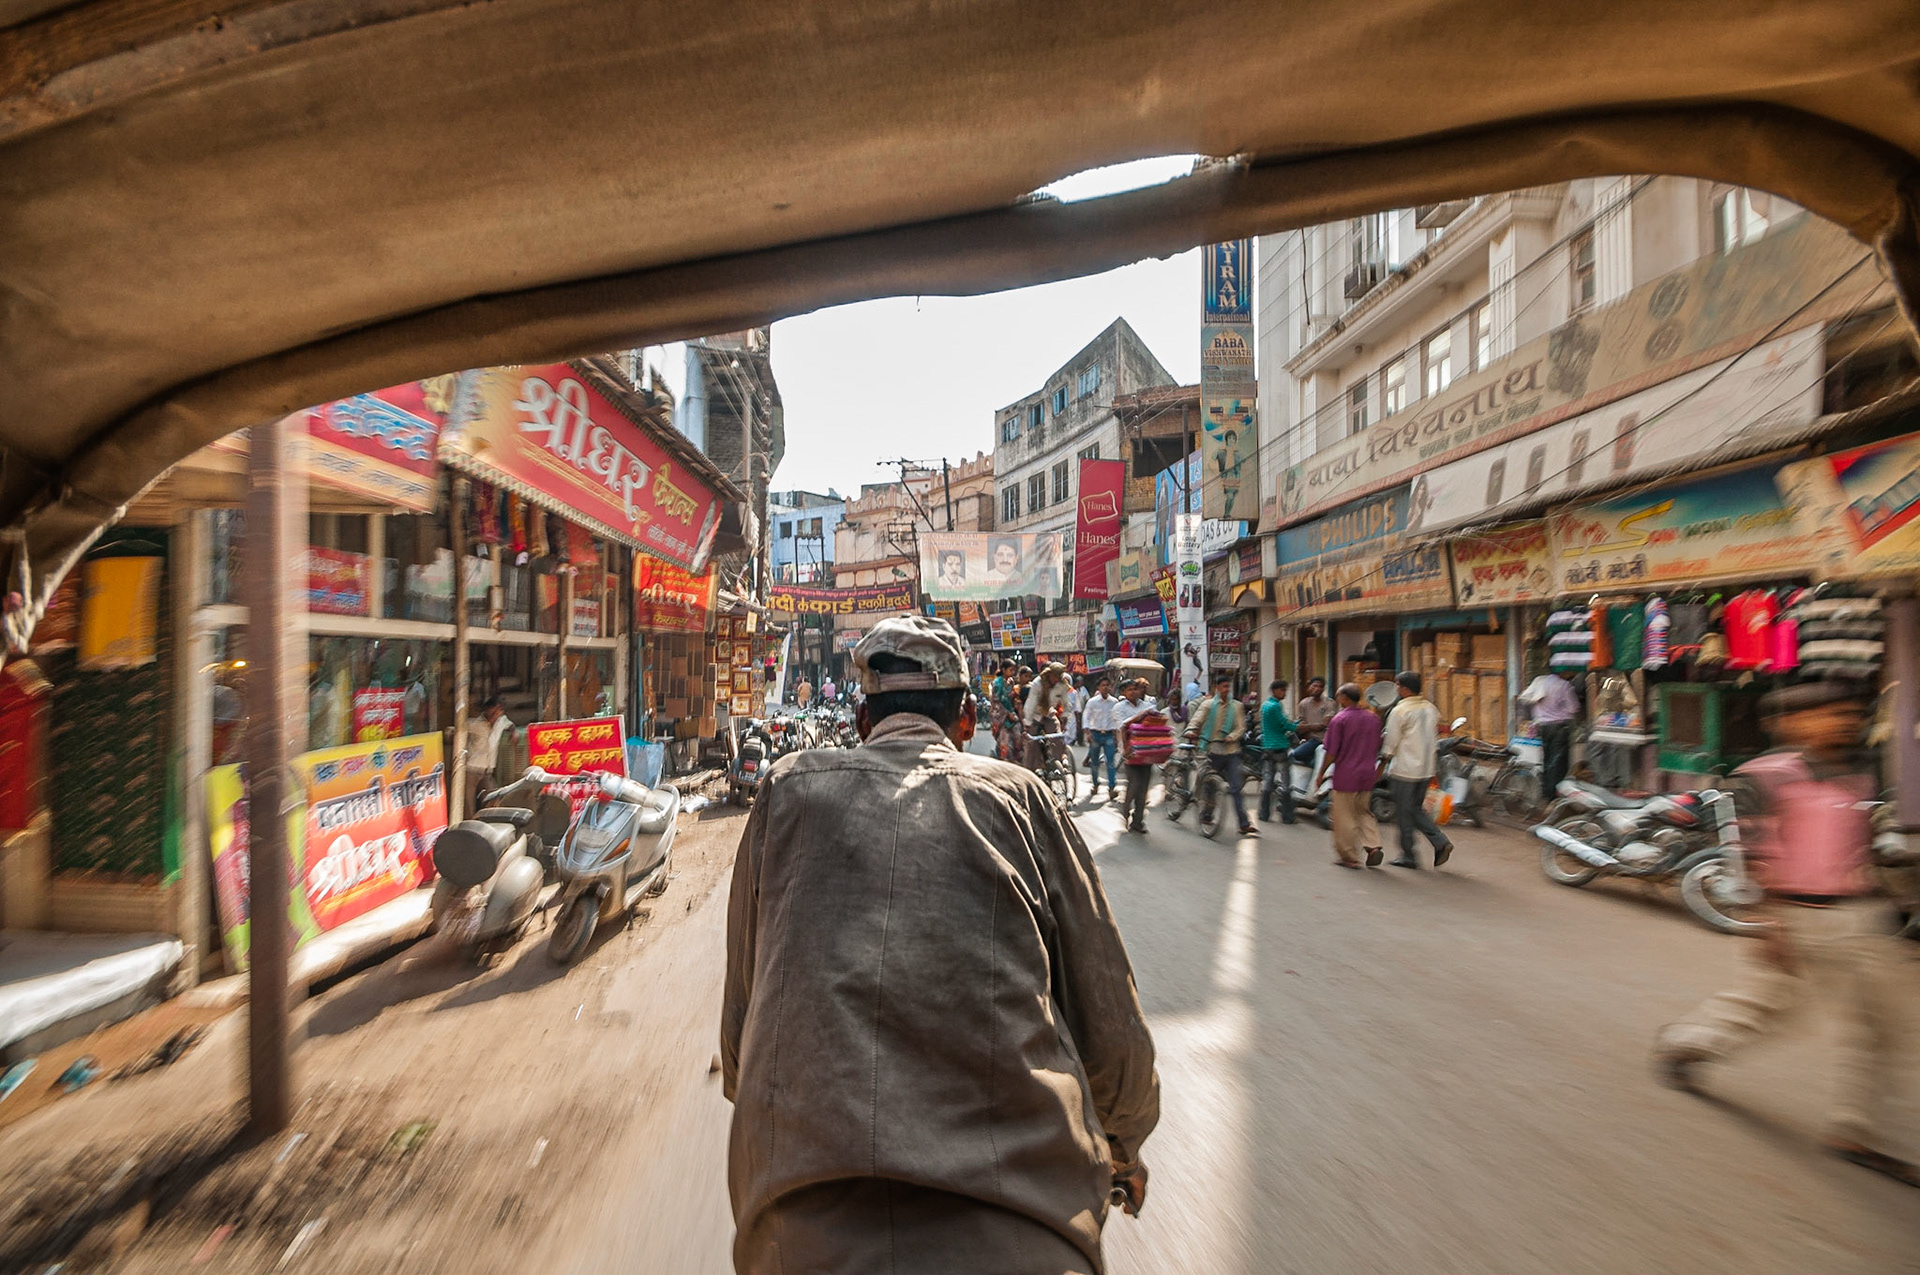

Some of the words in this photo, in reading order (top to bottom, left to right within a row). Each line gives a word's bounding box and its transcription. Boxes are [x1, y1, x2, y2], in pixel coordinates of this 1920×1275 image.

[1205, 311, 1250, 323] International
[1214, 337, 1244, 349] BABA
[1366, 360, 1547, 463] विश्वनाथ
[513, 376, 652, 522] श्रीधर
[1087, 501, 1113, 512] Hanes
[1320, 497, 1396, 550] PHILIPS
[1080, 531, 1116, 545] Hanes
[766, 593, 797, 612] ादी
[809, 597, 856, 614] कार्ड
[537, 728, 573, 750] एक
[577, 724, 614, 744] दाम
[531, 748, 563, 769] की
[567, 747, 623, 771] दुकान
